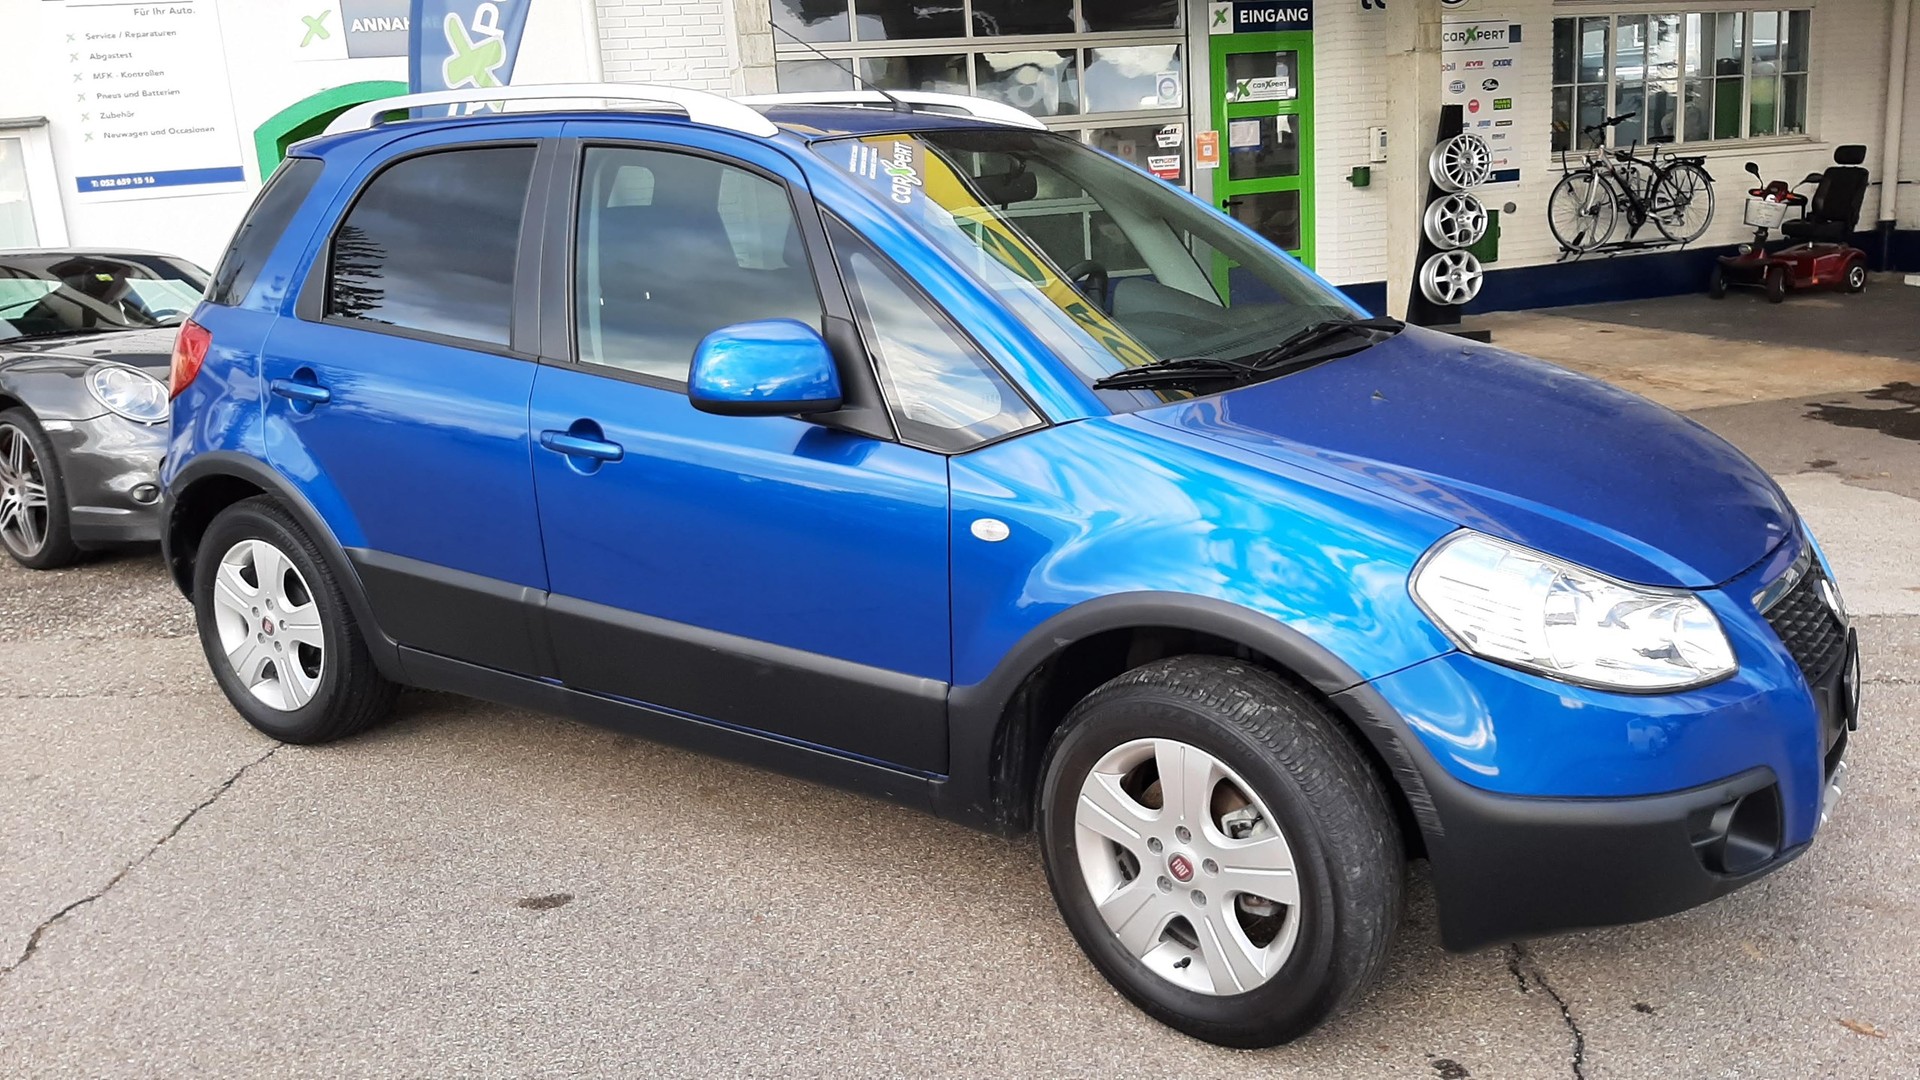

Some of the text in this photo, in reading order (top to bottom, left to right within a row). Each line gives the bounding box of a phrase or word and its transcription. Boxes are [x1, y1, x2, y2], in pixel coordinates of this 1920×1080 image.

[134, 7, 196, 16] Für Ihr Auto.
[1239, 8, 1309, 23] EINGANG
[85, 31, 116, 40] Service
[124, 29, 177, 39] Reparaturen
[89, 52, 133, 61] Abgastest
[93, 72, 113, 80] MFK
[120, 69, 165, 79] Kontrollen
[96, 88, 181, 100] Pneus und Batterien
[99, 111, 135, 120] Zubehör
[103, 125, 215, 140] Neuwagen und Occasionen
[100, 179, 115, 187] 052
